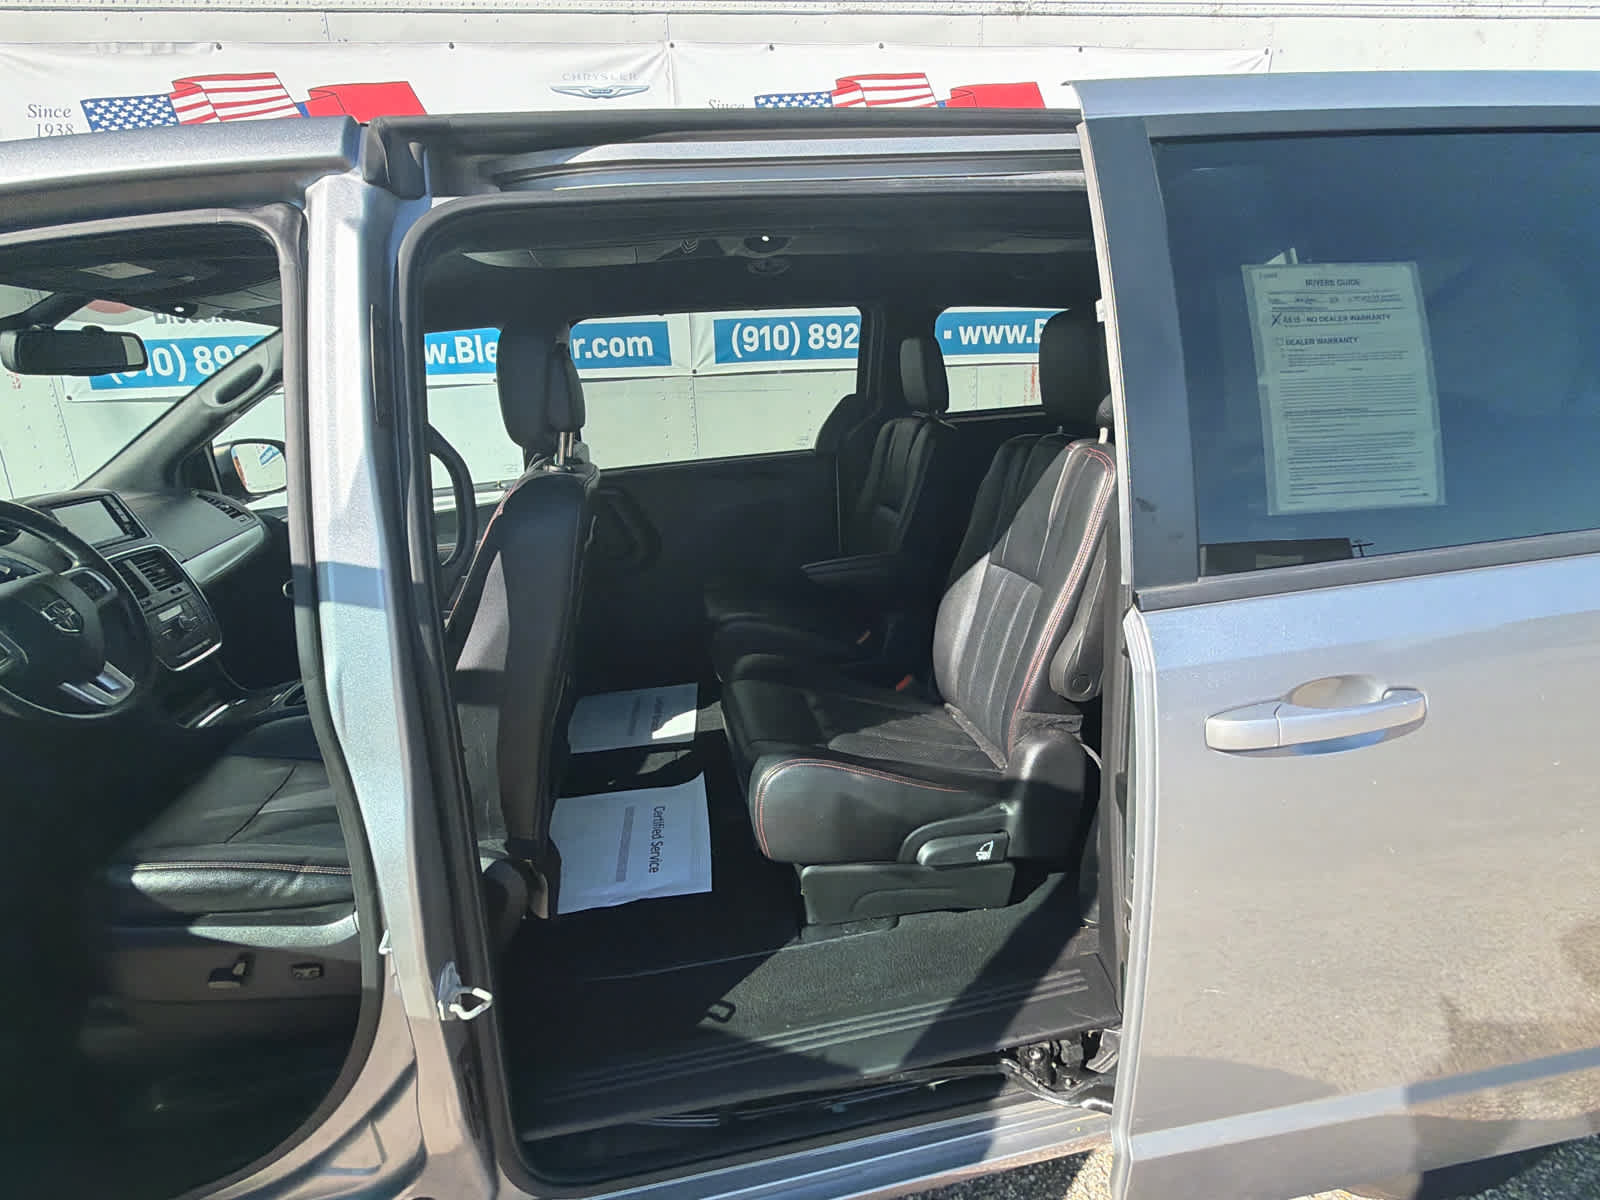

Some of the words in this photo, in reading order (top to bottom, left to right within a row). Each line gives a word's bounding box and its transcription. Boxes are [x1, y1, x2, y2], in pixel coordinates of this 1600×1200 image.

[561, 72, 641, 81] CHRYSLER
[27, 103, 72, 119] Since
[36, 122, 75, 137] 1938
[731, 320, 801, 359] (910)
[1285, 337, 1316, 346] DEALER
[1316, 335, 1360, 345] WARRANTY
[192, 344, 251, 377] 89
[651, 805, 666, 840] Certified
[648, 840, 664, 873] Service
